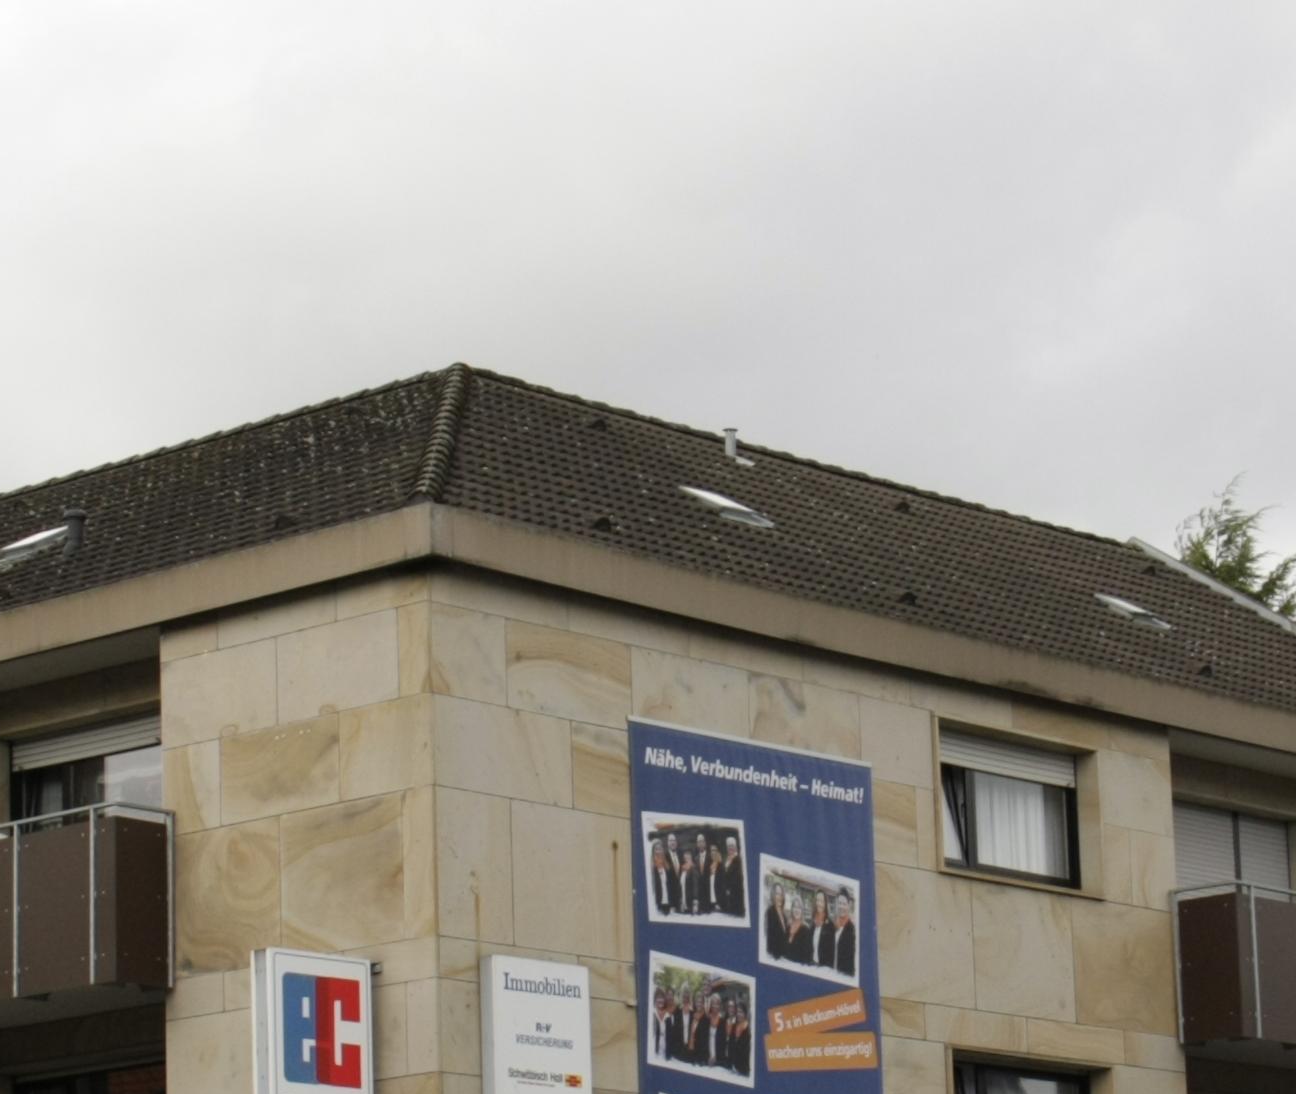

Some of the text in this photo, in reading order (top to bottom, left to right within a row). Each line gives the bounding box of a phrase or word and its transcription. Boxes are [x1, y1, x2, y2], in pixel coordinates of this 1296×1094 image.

[645, 747, 687, 773] Nähe,
[691, 756, 797, 792] Verbundenheit
[811, 779, 864, 804] Heimat!
[503, 972, 581, 999] Immobilien
[774, 1011, 784, 1032] 5
[515, 1034, 574, 1050] VERSICHERUNG
